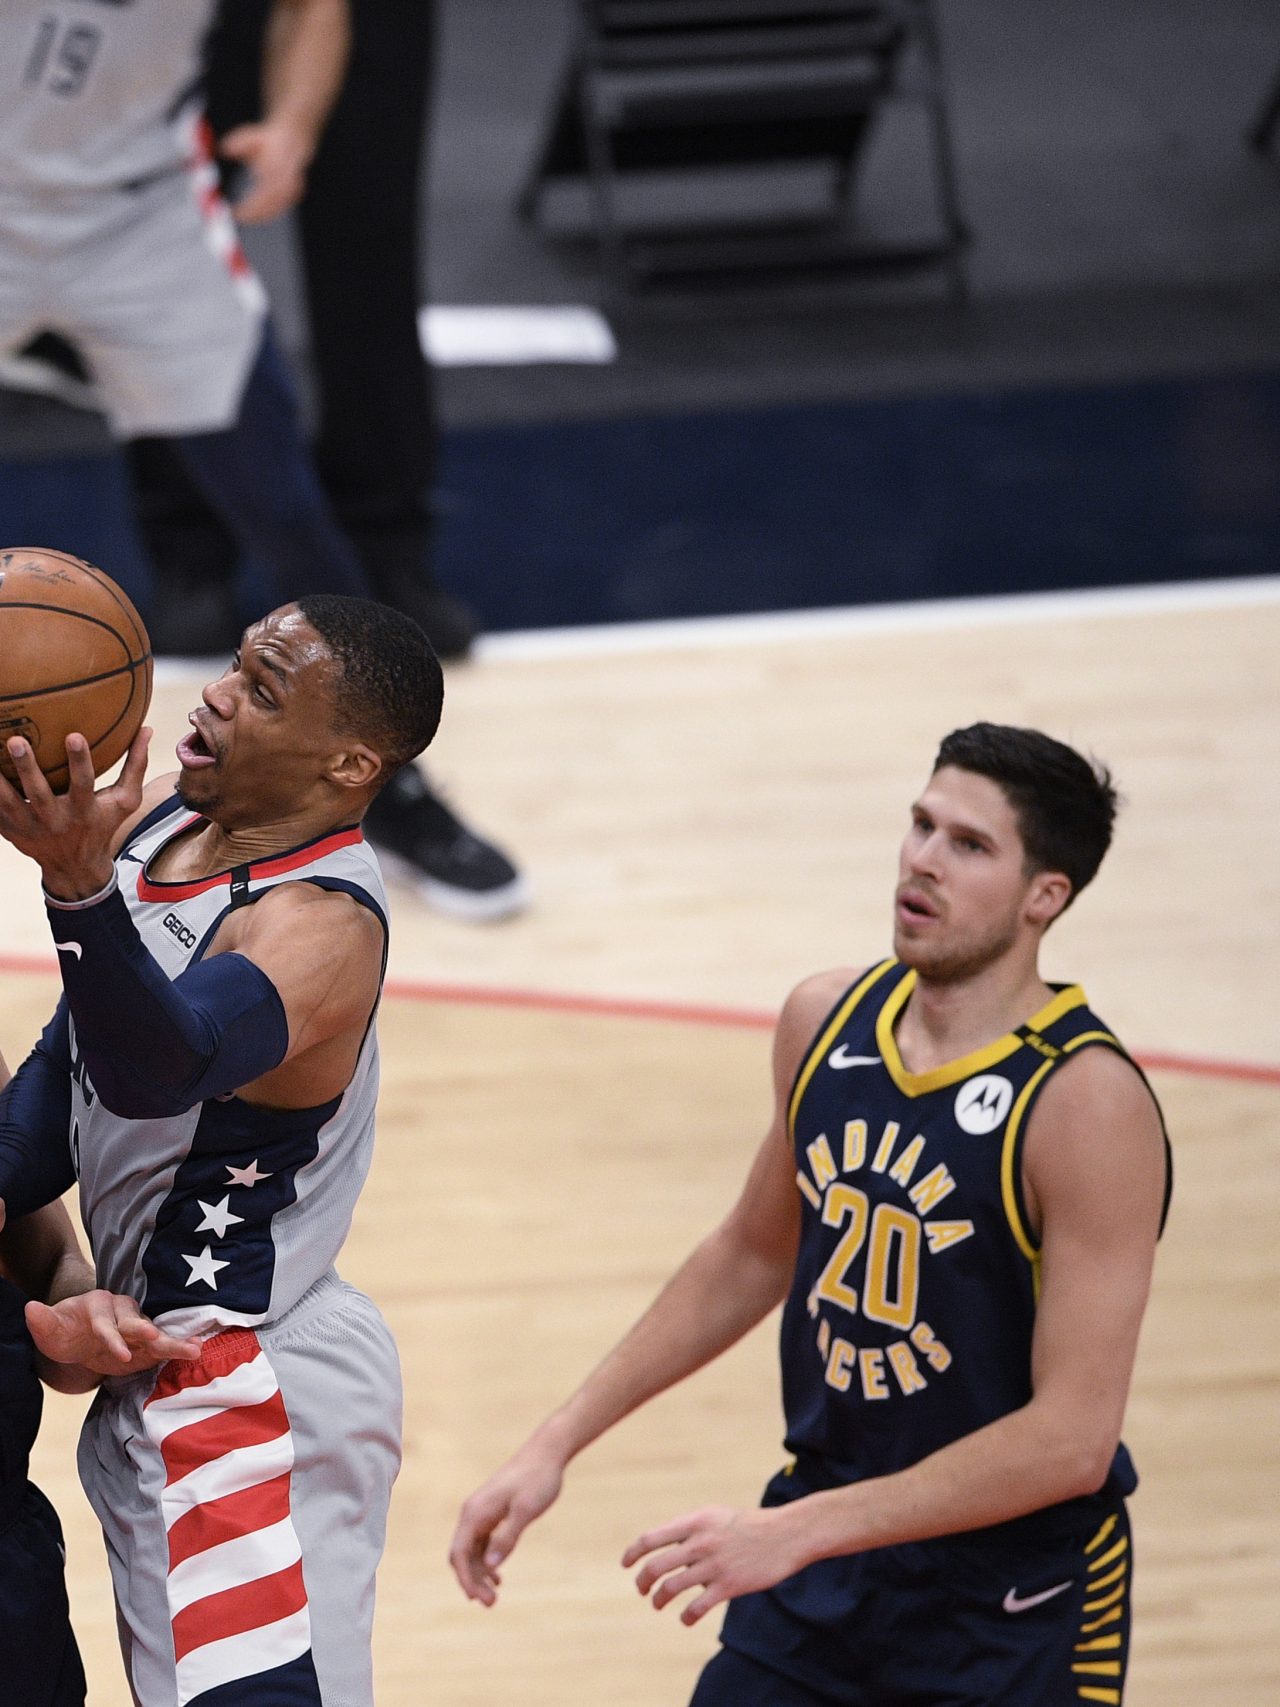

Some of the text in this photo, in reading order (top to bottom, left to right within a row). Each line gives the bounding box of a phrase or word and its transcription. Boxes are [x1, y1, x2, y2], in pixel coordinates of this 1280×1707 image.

[23, 14, 102, 97] 19
[163, 913, 196, 949] GEICO
[796, 1118, 975, 1254] INDIANA
[816, 1181, 921, 1331] 20
